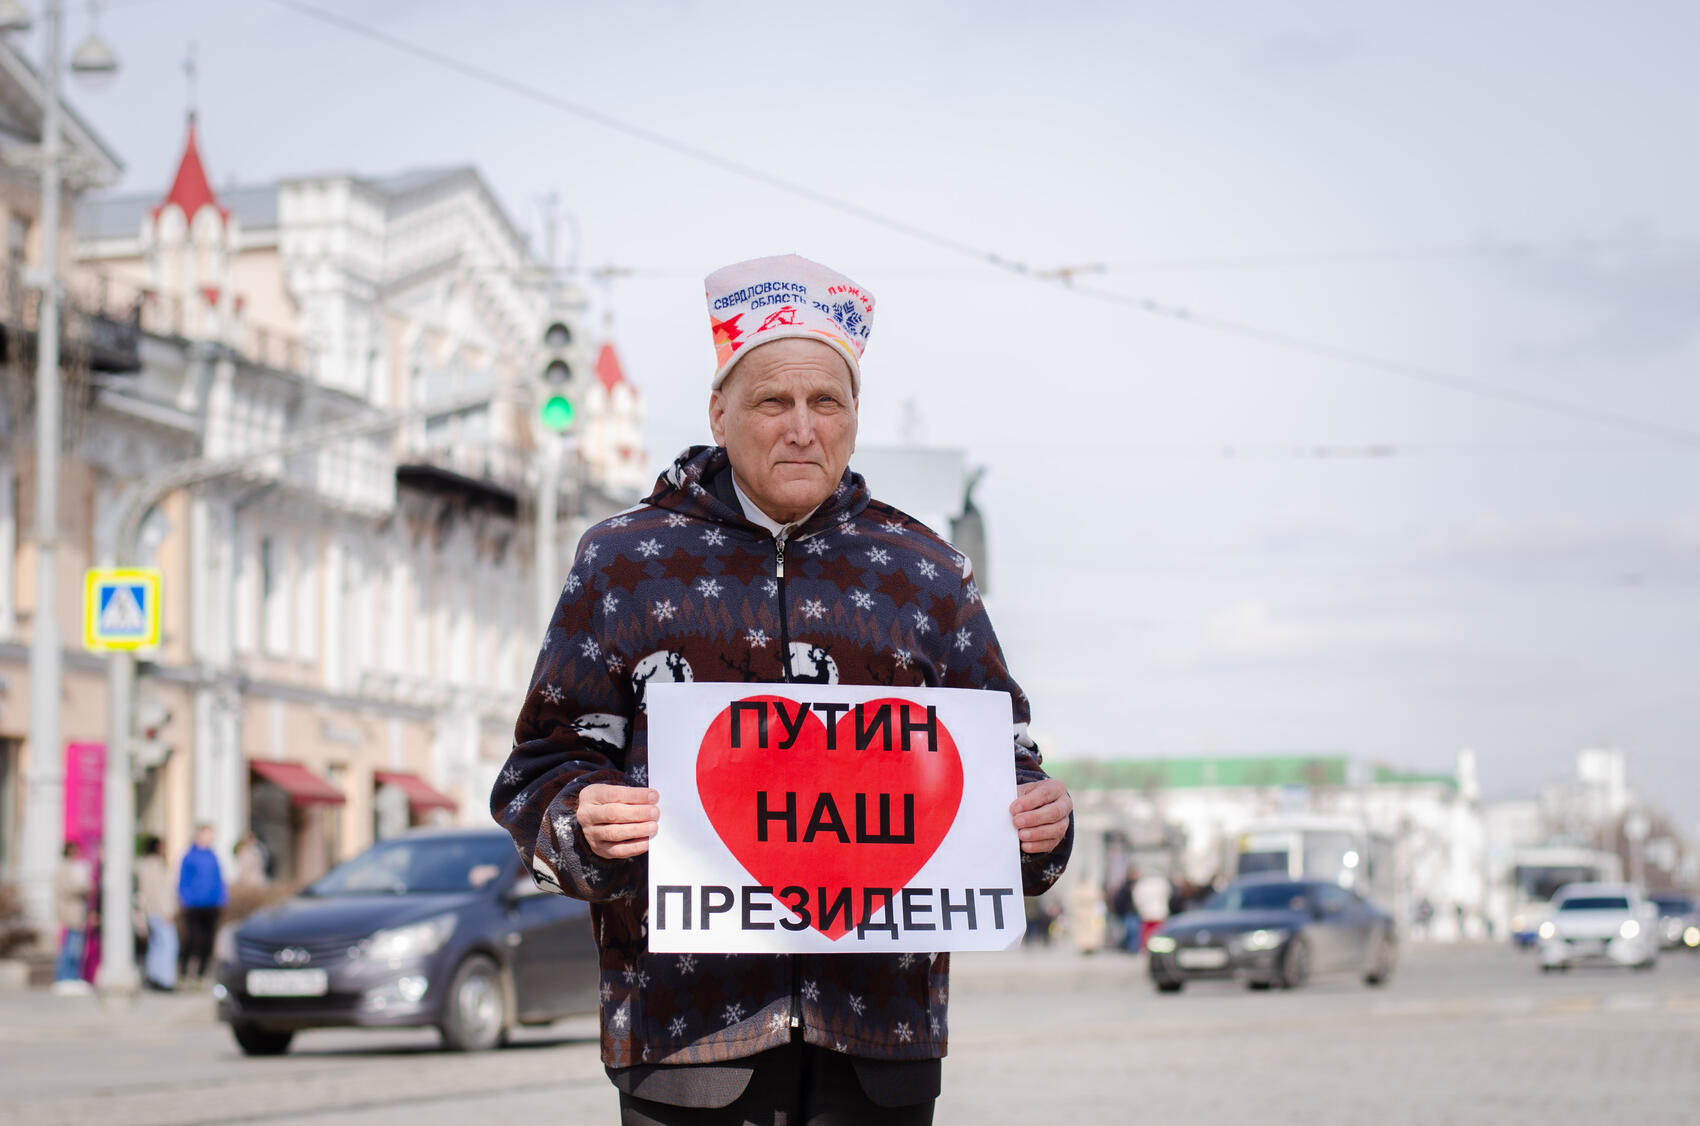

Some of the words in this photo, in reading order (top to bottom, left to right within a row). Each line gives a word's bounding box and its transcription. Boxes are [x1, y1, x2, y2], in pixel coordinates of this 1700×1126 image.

[714, 282, 806, 310] СВЕРДЛОВСКАЯ
[751, 294, 806, 310] ОБЛАСТЬ
[730, 702, 938, 752] ПУТИН
[756, 791, 915, 844] НАШ
[656, 885, 1013, 940] ПРЕЗИДЕНТ
